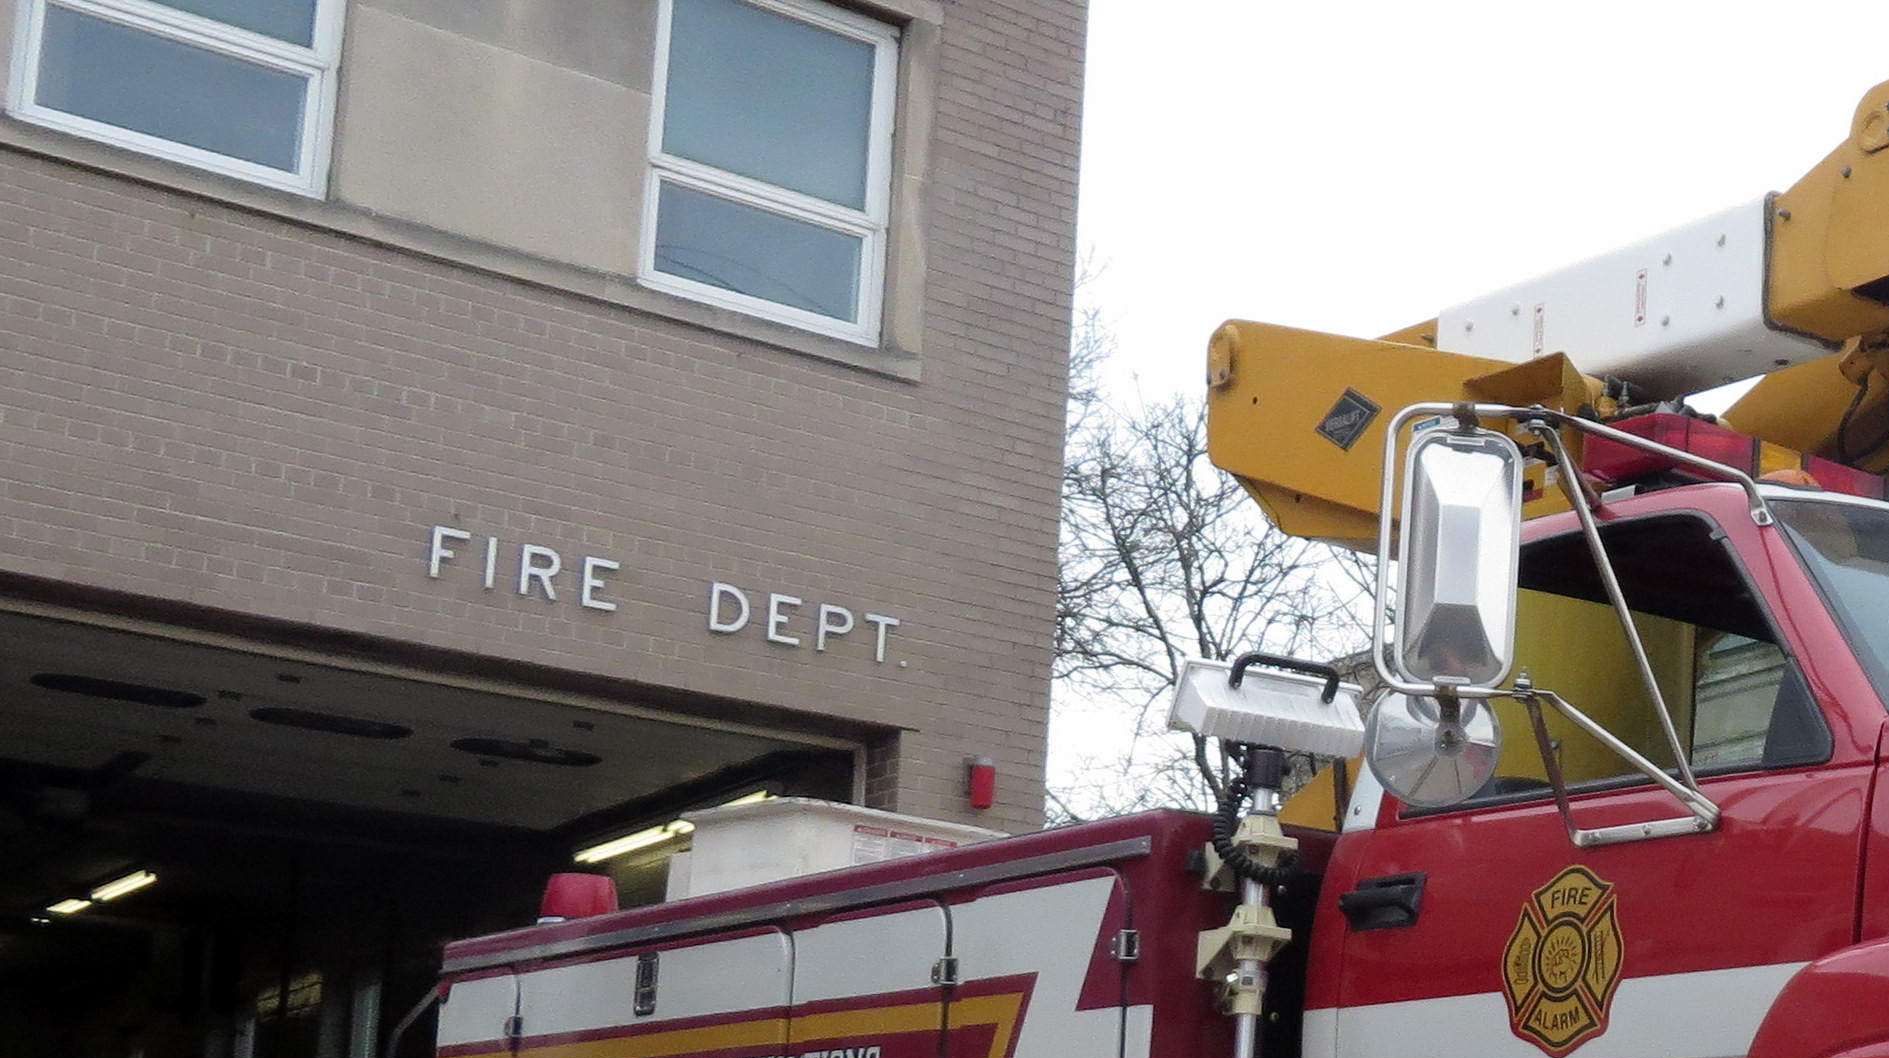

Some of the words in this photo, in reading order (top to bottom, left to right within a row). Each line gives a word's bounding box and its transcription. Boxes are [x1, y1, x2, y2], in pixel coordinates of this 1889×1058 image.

[428, 525, 621, 612] FIRE
[708, 581, 908, 668] DEPT.
[1550, 886, 1593, 909] FIRE
[1532, 1005, 1581, 1032] ALARM
